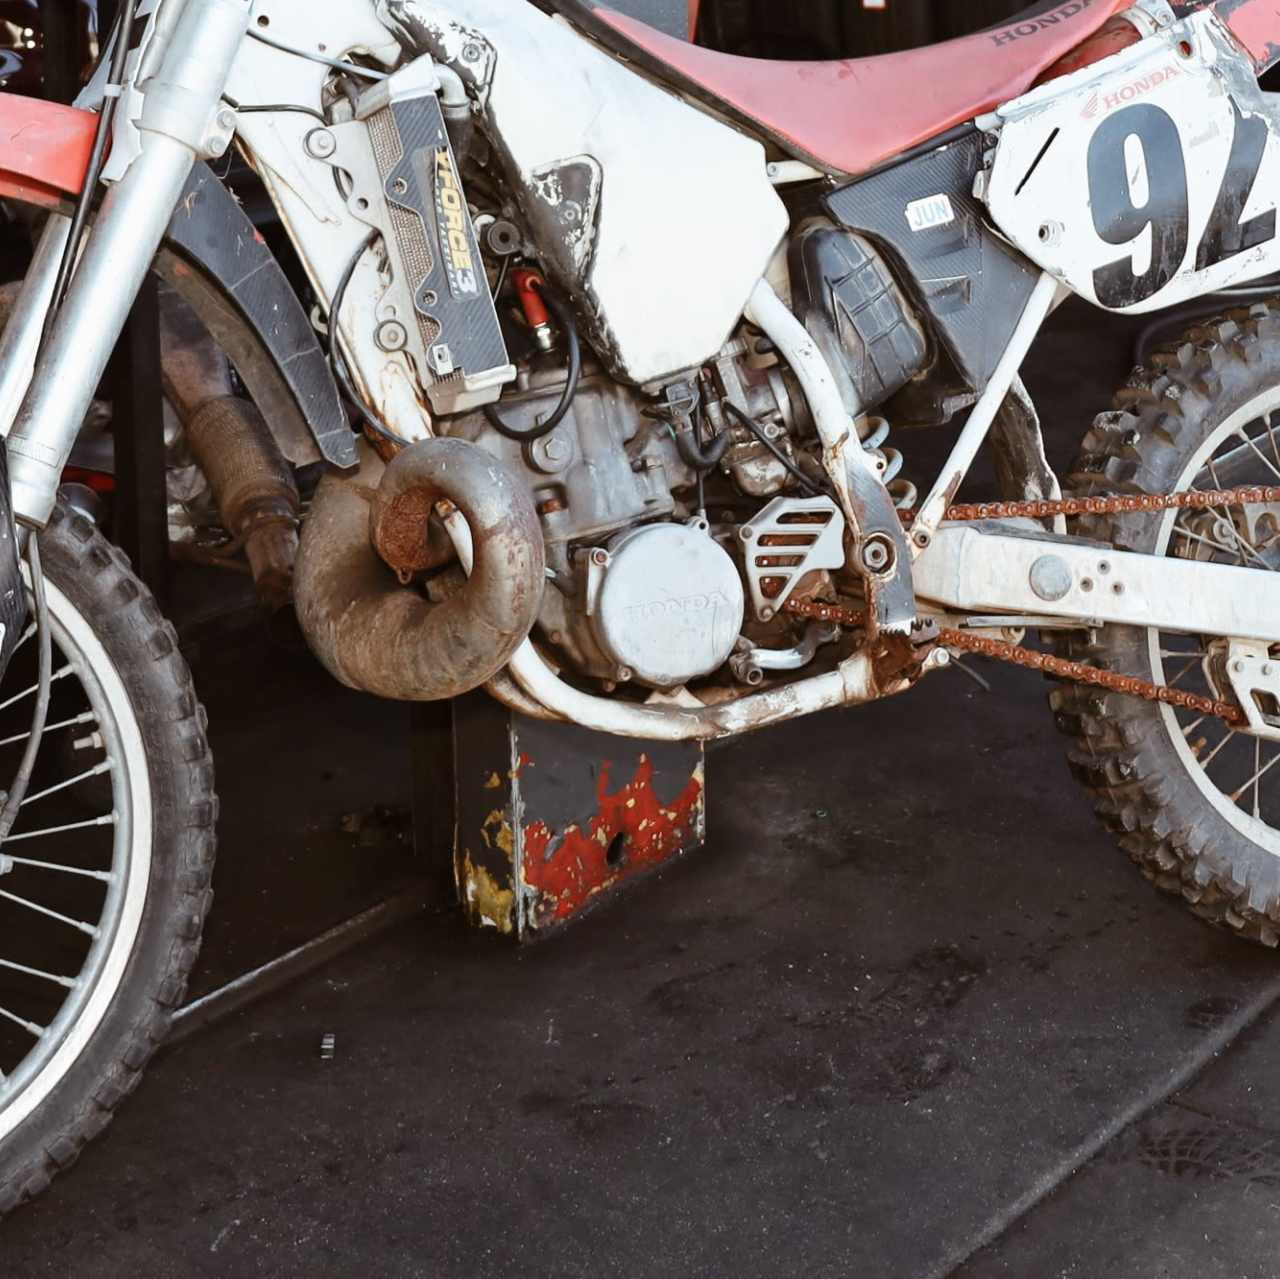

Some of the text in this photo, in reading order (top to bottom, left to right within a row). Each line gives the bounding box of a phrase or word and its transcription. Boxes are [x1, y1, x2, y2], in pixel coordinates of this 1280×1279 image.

[1103, 65, 1182, 110] HONDA
[914, 200, 950, 226] JUN
[1087, 94, 1276, 308] 92
